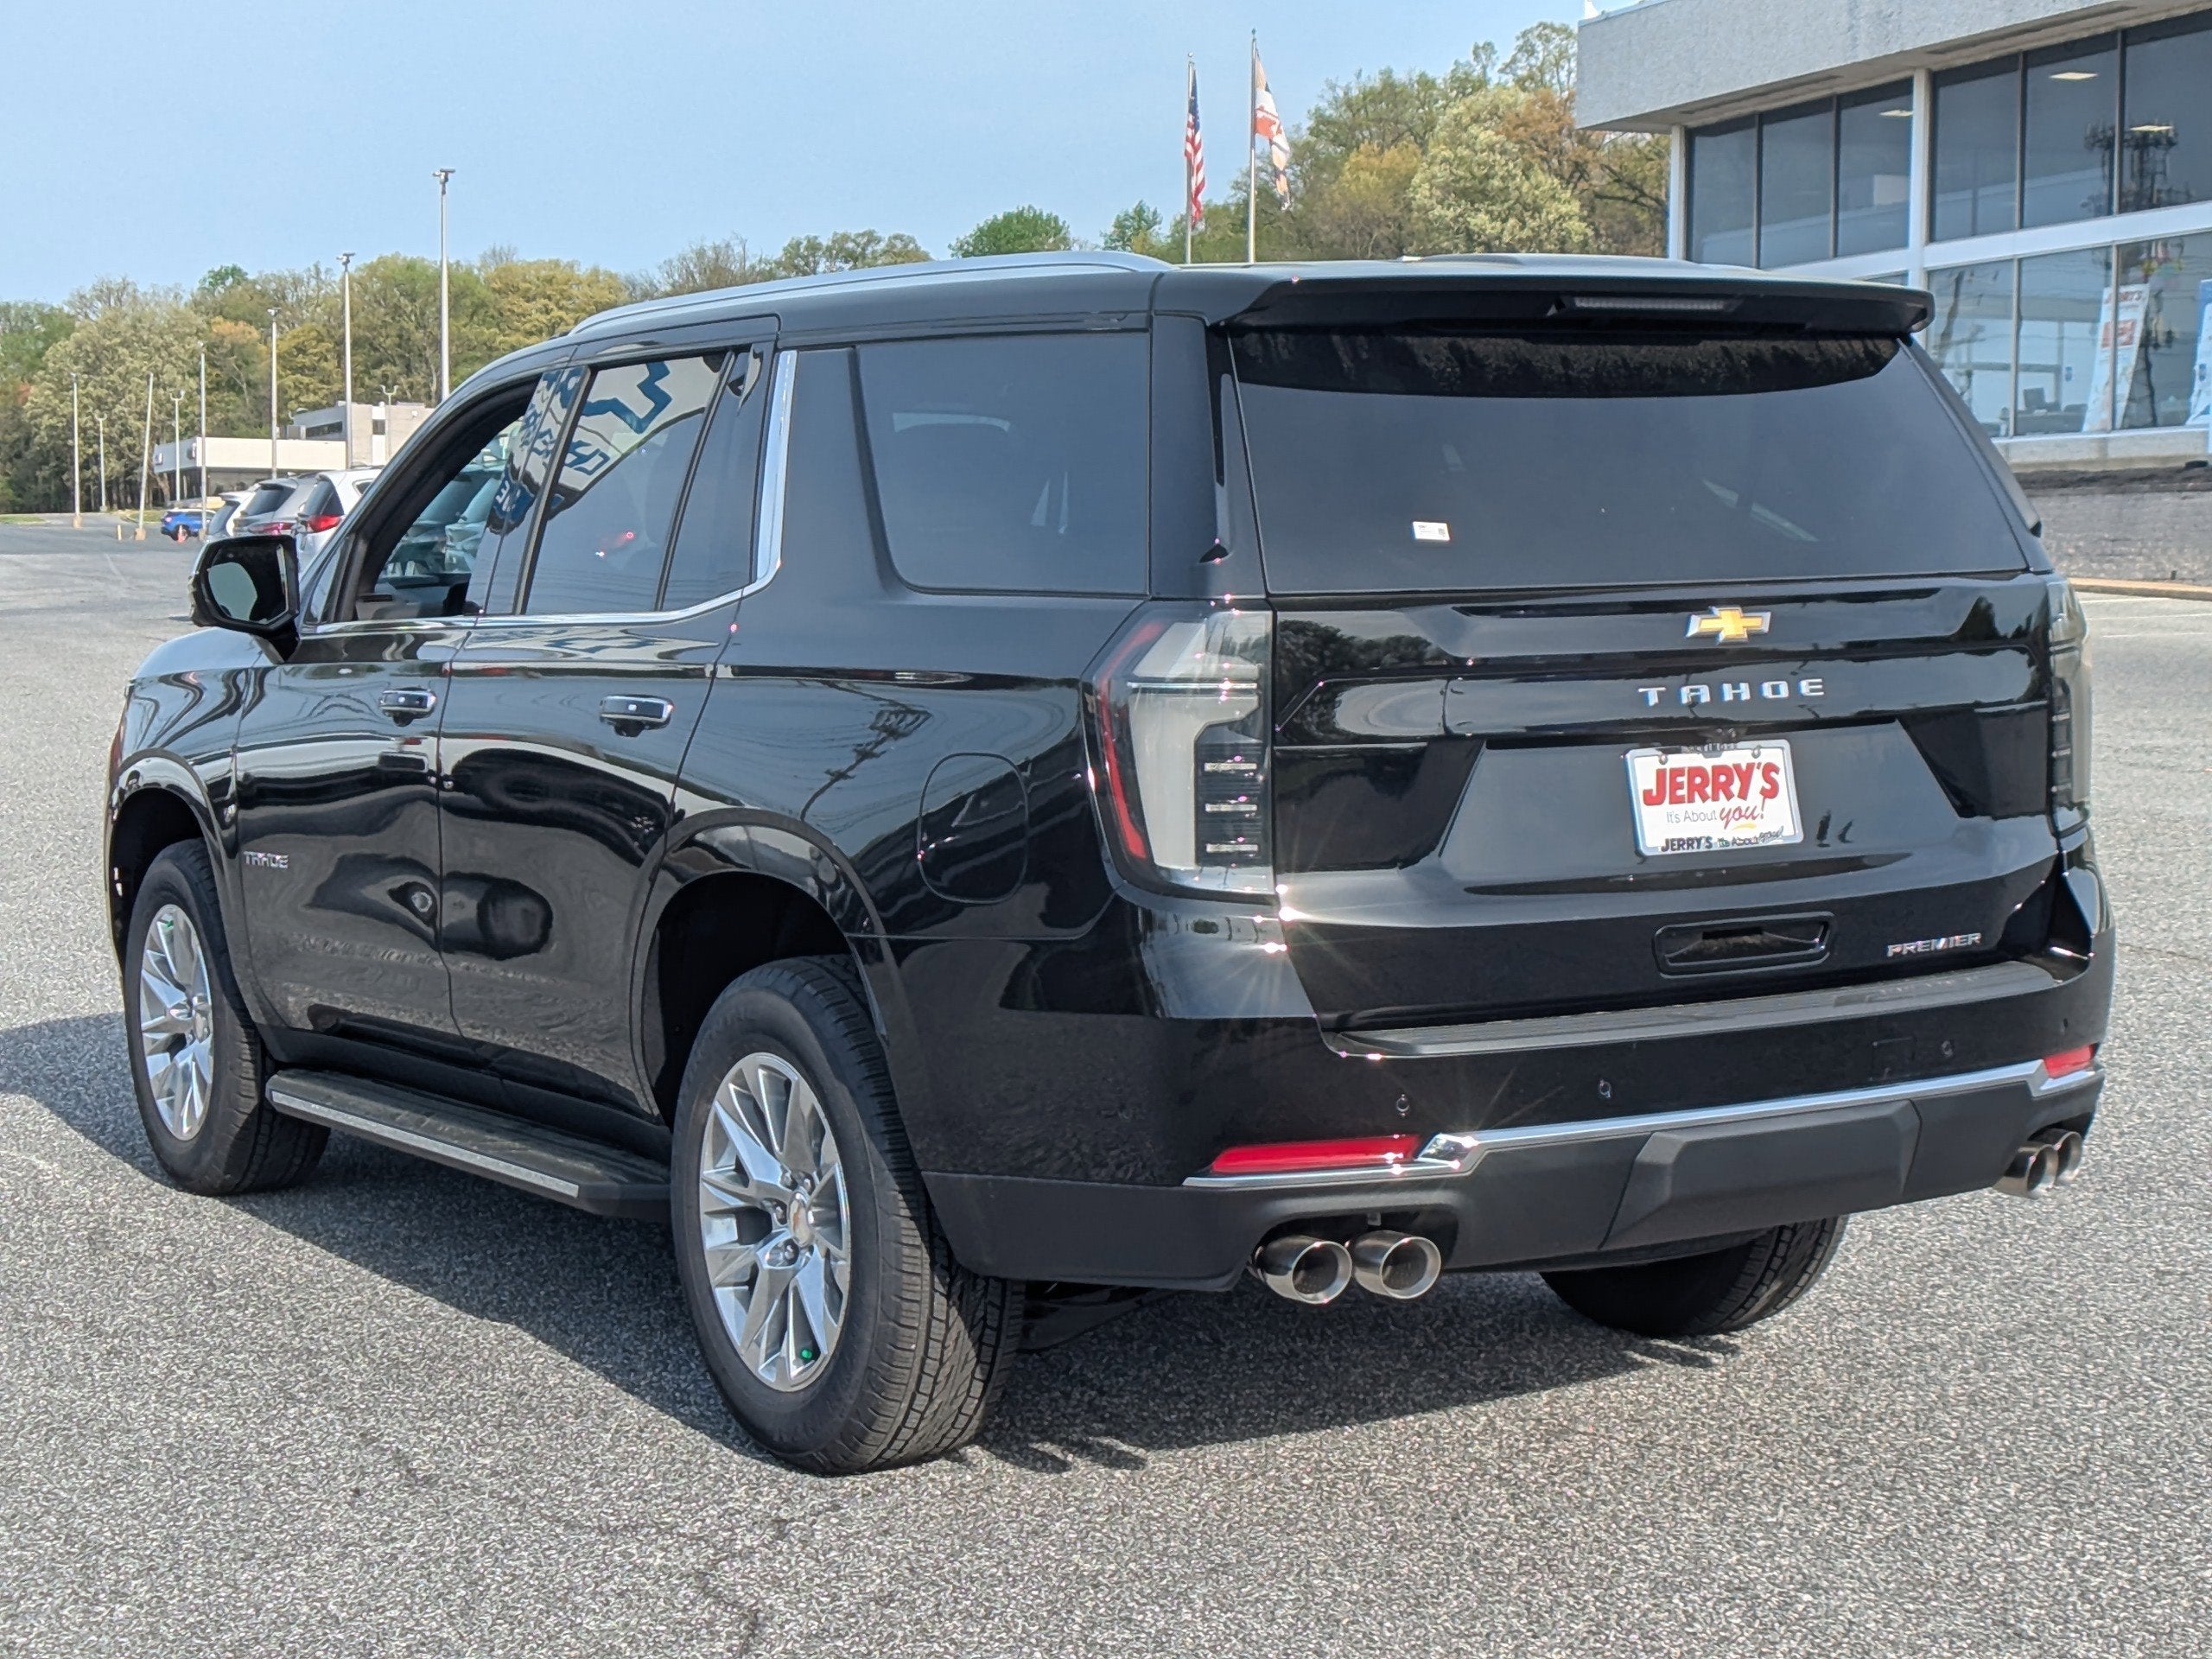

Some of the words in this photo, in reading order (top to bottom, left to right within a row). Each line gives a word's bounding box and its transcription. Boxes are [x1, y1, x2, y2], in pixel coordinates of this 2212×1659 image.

[1638, 678, 1825, 707] TAHOE
[1643, 762, 1780, 806] JERRY'S
[1667, 810, 1680, 823] It's
[1683, 810, 1717, 823] About
[1719, 798, 1766, 830] you!
[1661, 836, 1713, 852] JERRY'S
[1886, 932, 1981, 957] PREMIER
